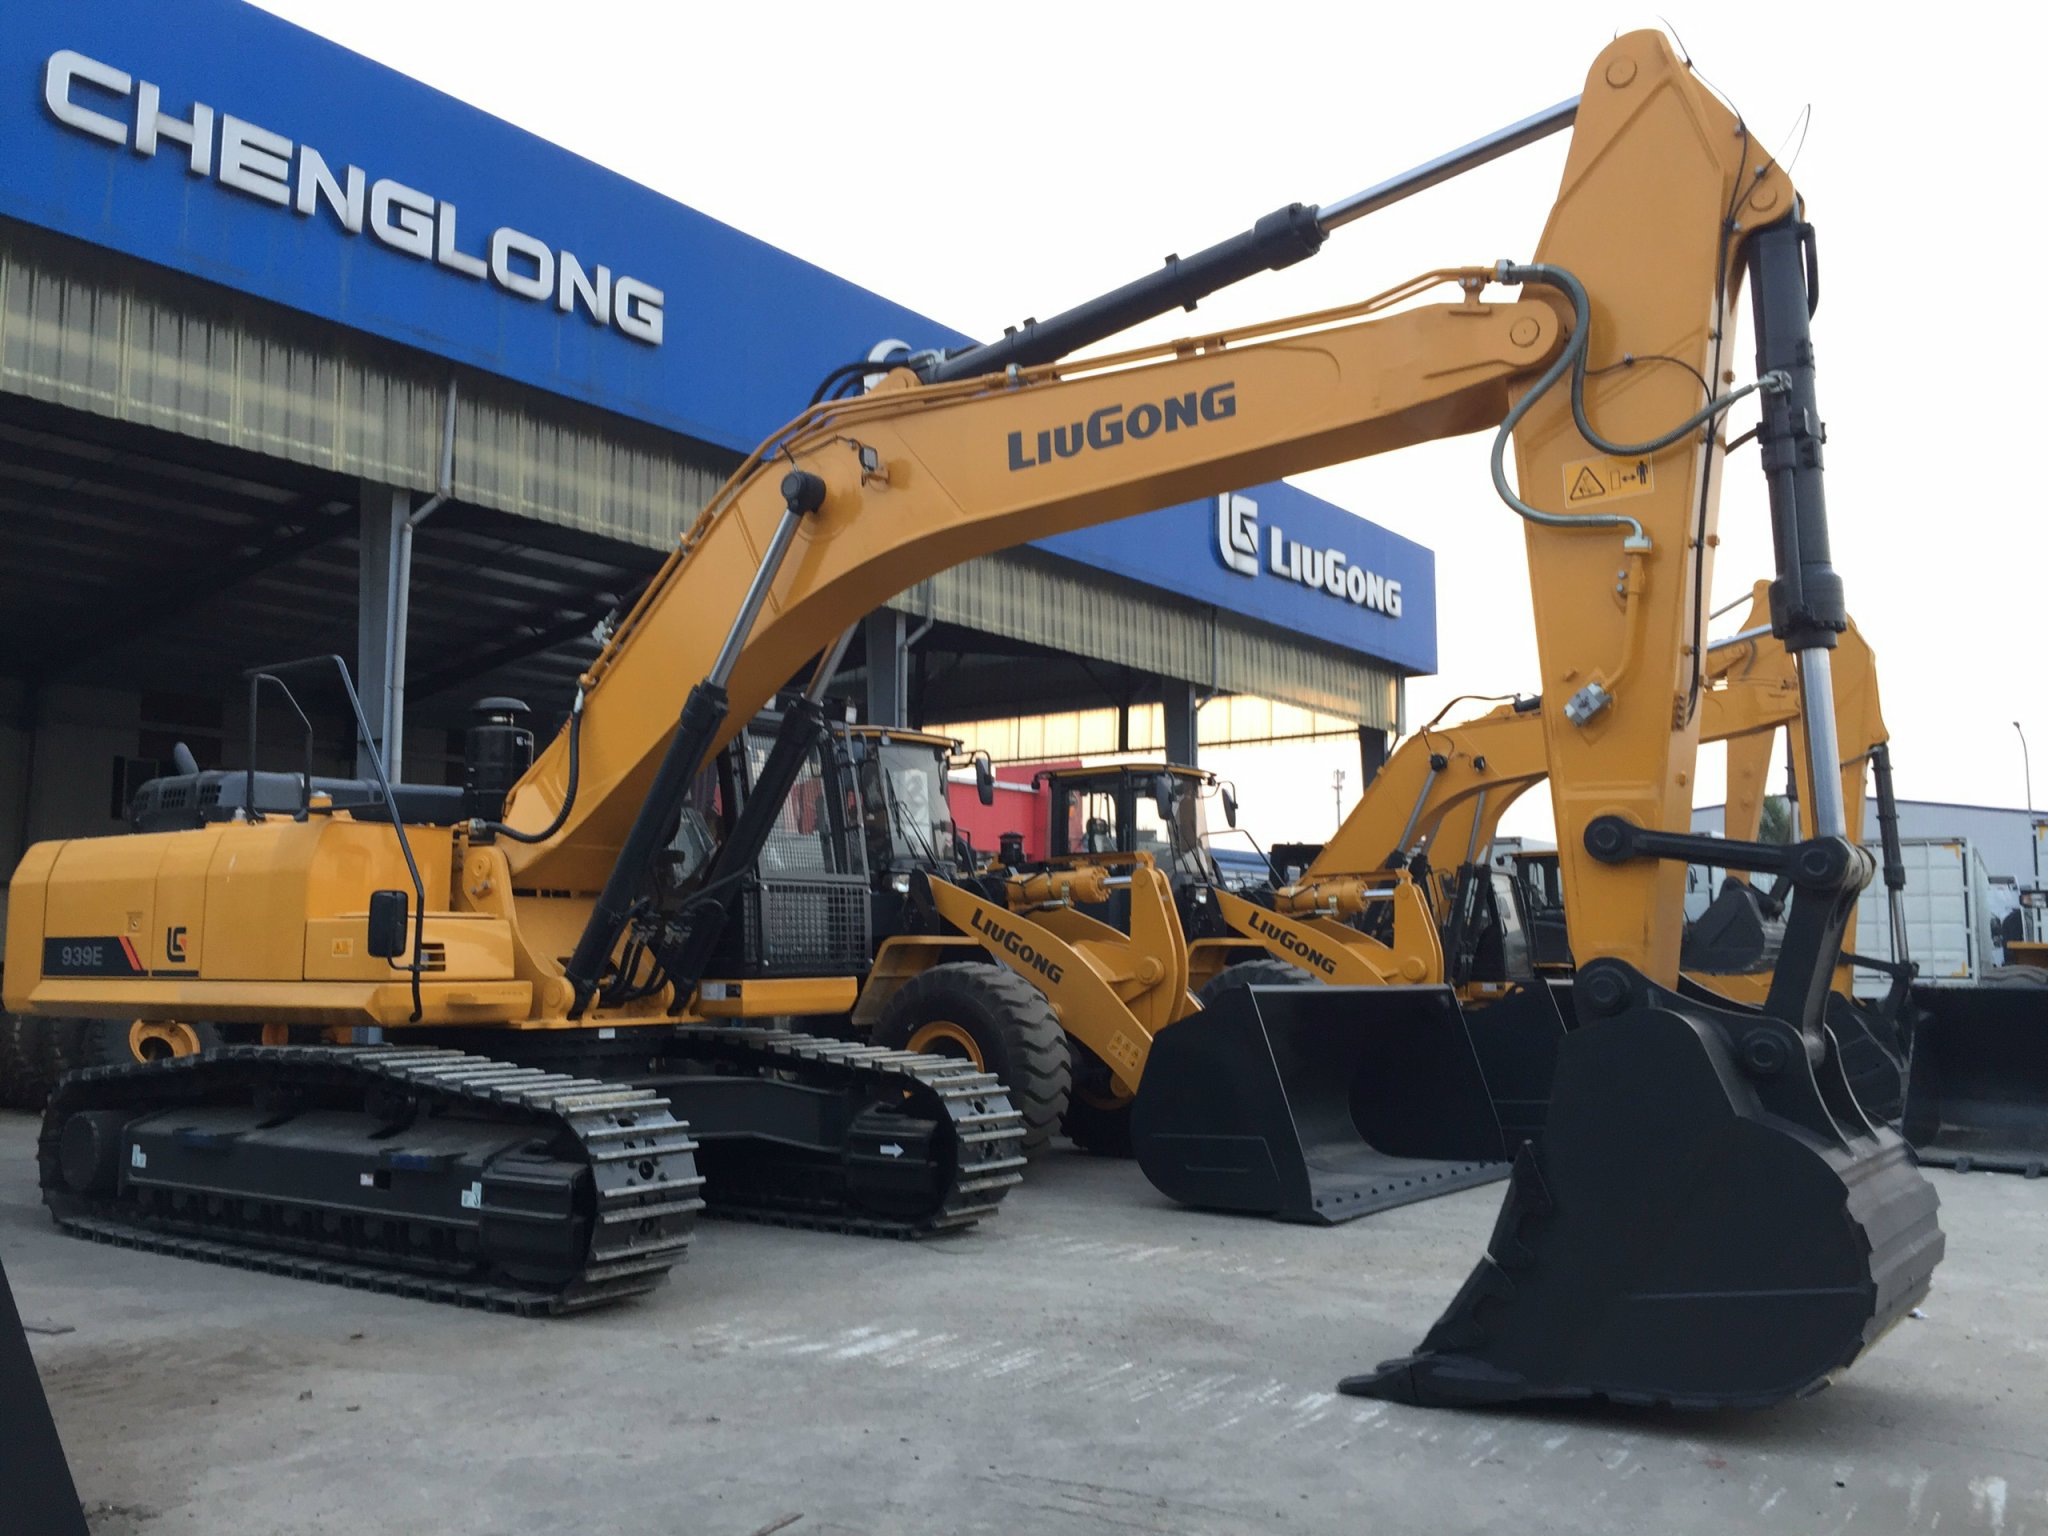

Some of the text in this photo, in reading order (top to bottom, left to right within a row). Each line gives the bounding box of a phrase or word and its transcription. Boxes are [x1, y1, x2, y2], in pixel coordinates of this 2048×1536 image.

[45, 49, 665, 346] CHENGLONG
[1007, 380, 1237, 473] LIUGONG
[1270, 525, 1402, 618] LIUGONG
[61, 946, 104, 967] 939E
[970, 907, 1065, 985] LIUGONG
[1248, 911, 1337, 976] LIUGONG
